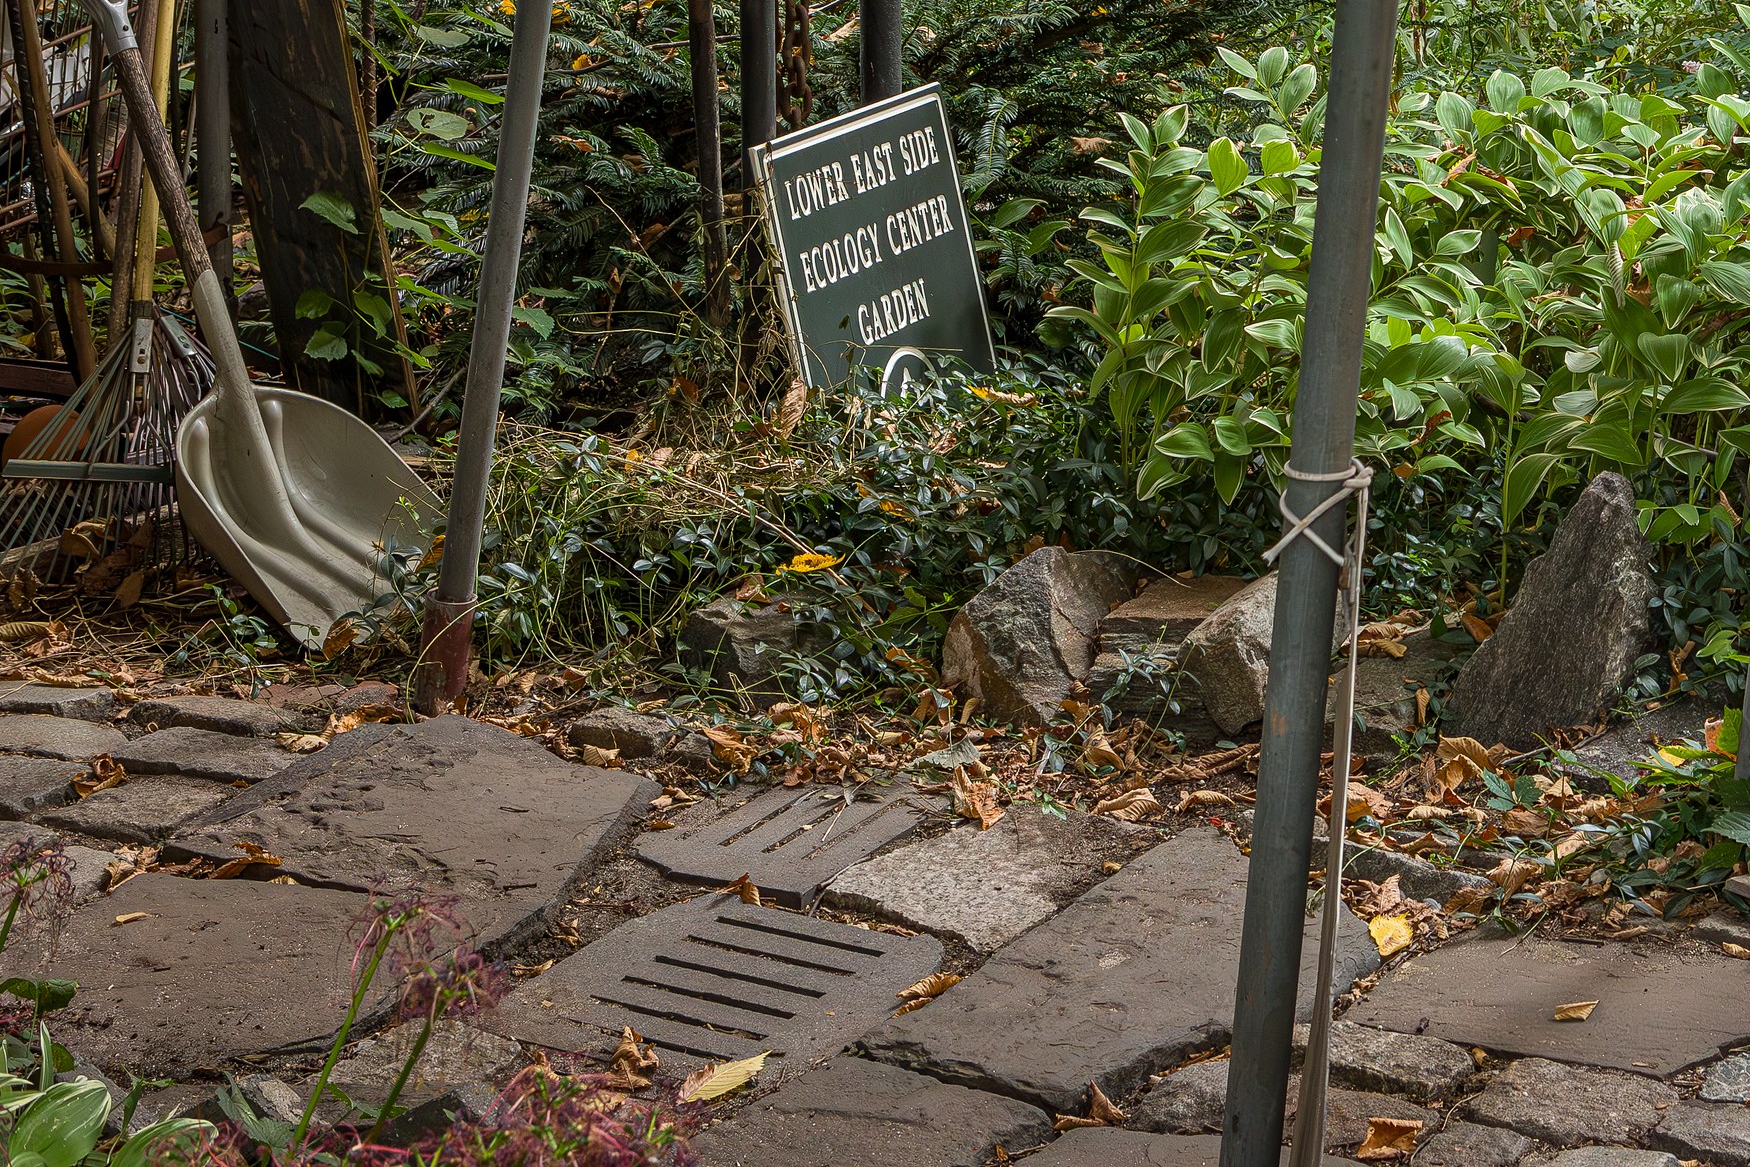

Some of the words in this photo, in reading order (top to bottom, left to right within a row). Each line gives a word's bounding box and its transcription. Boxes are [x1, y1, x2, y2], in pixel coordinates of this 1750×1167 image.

[784, 162, 849, 220] LOWER
[851, 143, 897, 194] EAST
[899, 125, 941, 175] SIDE
[799, 222, 883, 294] ECOLOGY
[886, 194, 955, 255] CENTER
[857, 278, 931, 346] GARDEN
